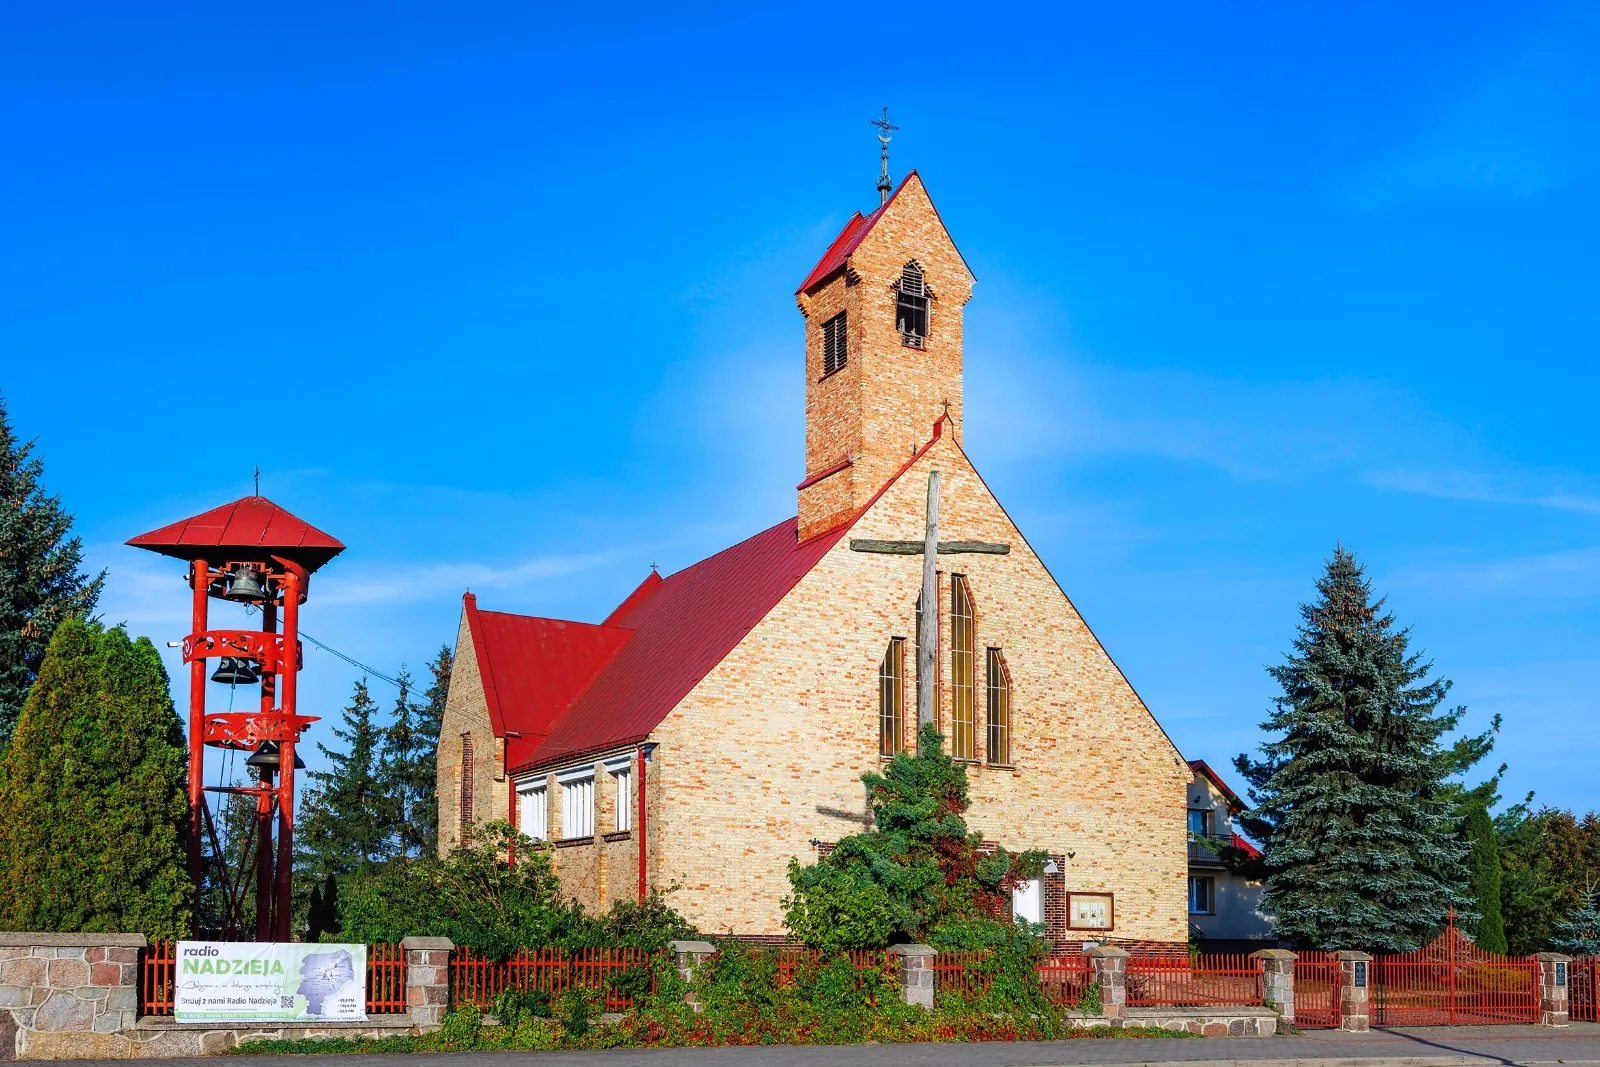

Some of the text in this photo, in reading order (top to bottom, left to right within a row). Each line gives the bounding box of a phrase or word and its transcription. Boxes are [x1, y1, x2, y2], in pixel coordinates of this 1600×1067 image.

[183, 945, 219, 957] radio
[183, 958, 285, 976] NADZIEJA
[207, 996, 226, 1005] nami
[227, 996, 247, 1005] Radio
[248, 997, 277, 1006] Nadzieja
